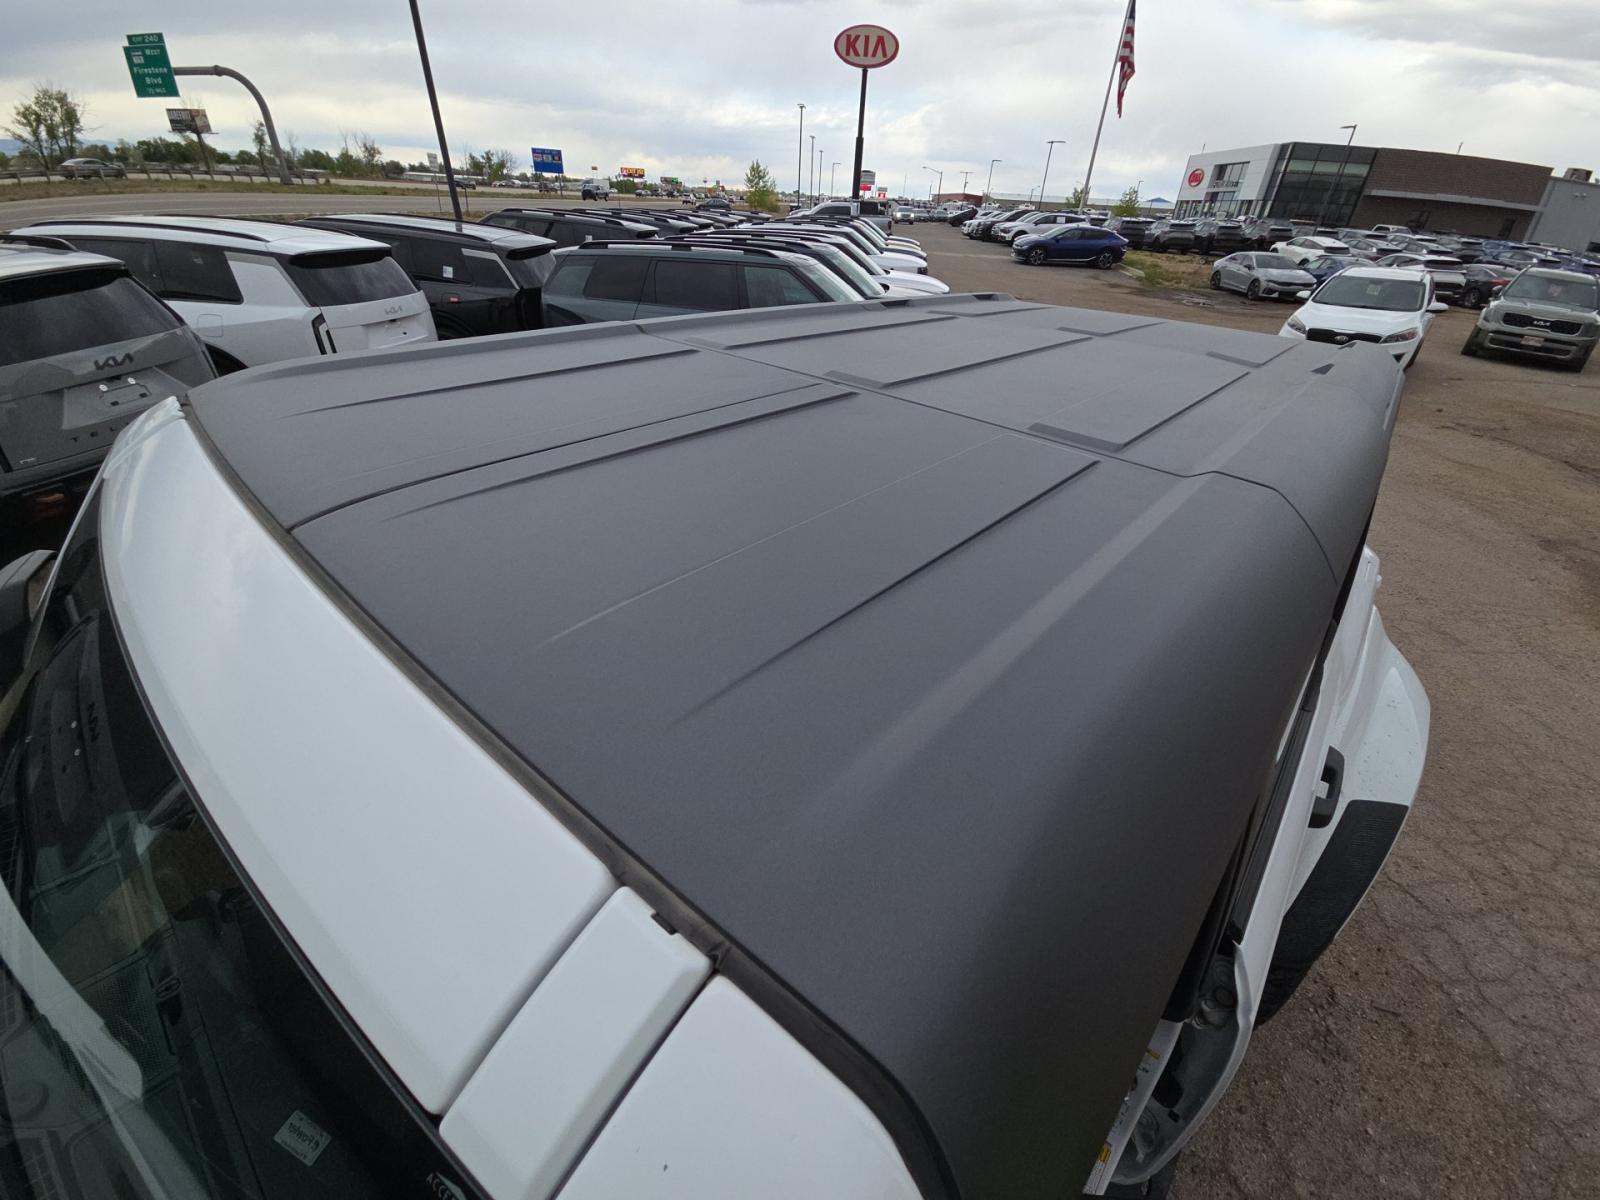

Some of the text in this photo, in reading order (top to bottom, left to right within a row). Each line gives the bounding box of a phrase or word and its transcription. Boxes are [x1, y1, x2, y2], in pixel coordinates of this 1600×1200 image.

[845, 34, 887, 58] KIA
[145, 76, 162, 84] Blvd
[94, 353, 134, 370] KIA
